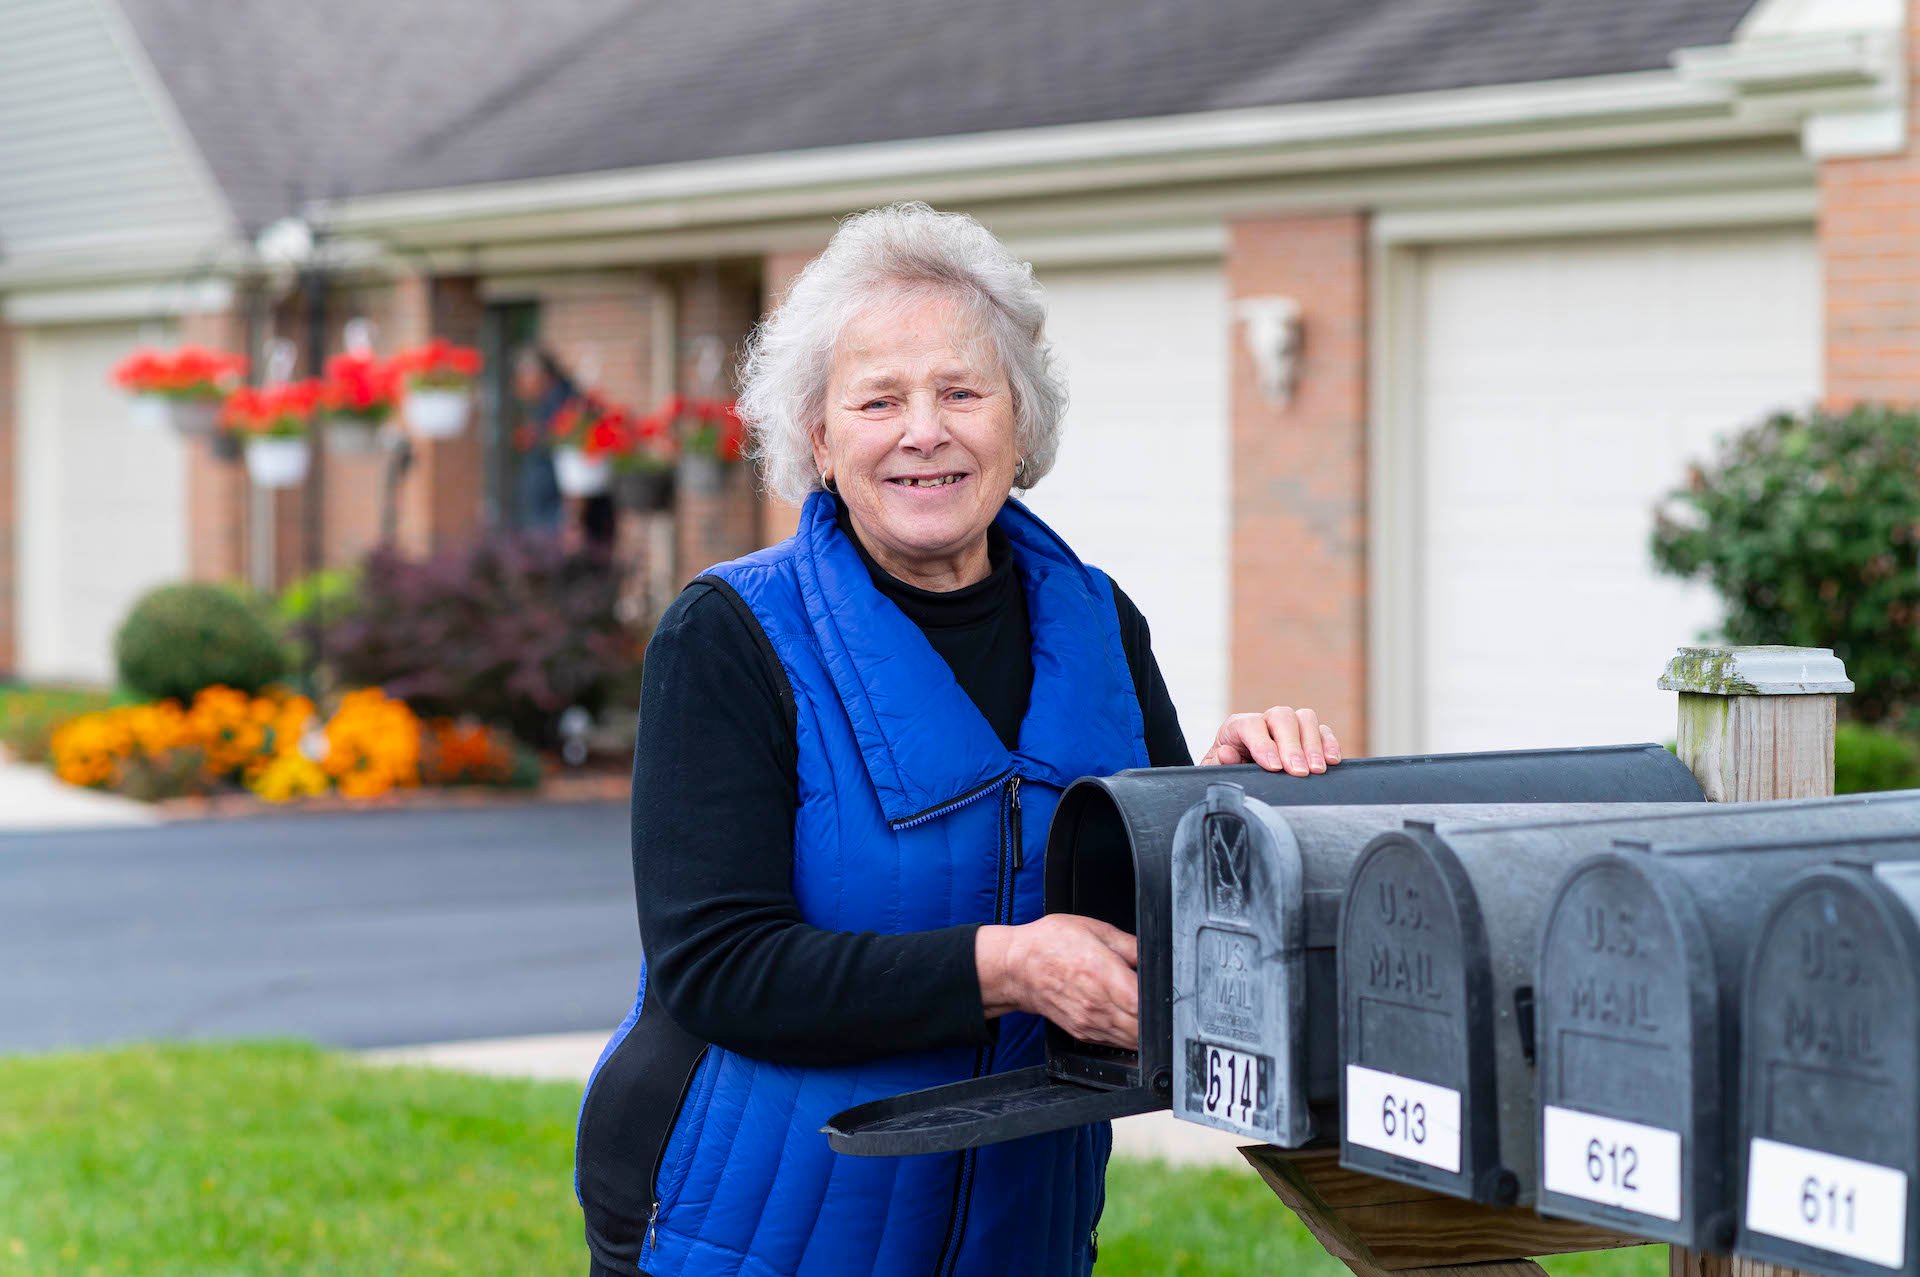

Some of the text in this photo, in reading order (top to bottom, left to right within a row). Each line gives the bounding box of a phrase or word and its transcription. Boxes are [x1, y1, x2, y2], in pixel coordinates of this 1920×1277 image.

[1215, 974, 1251, 1010] MAIL
[1369, 942, 1442, 999] MAIL
[1570, 976, 1659, 1030] MAIL
[1784, 995, 1885, 1069] MAIL
[1207, 1049, 1252, 1122] 614
[1382, 1094, 1427, 1145] 613
[1586, 1138, 1639, 1192] 612
[1800, 1176, 1856, 1234] 611
